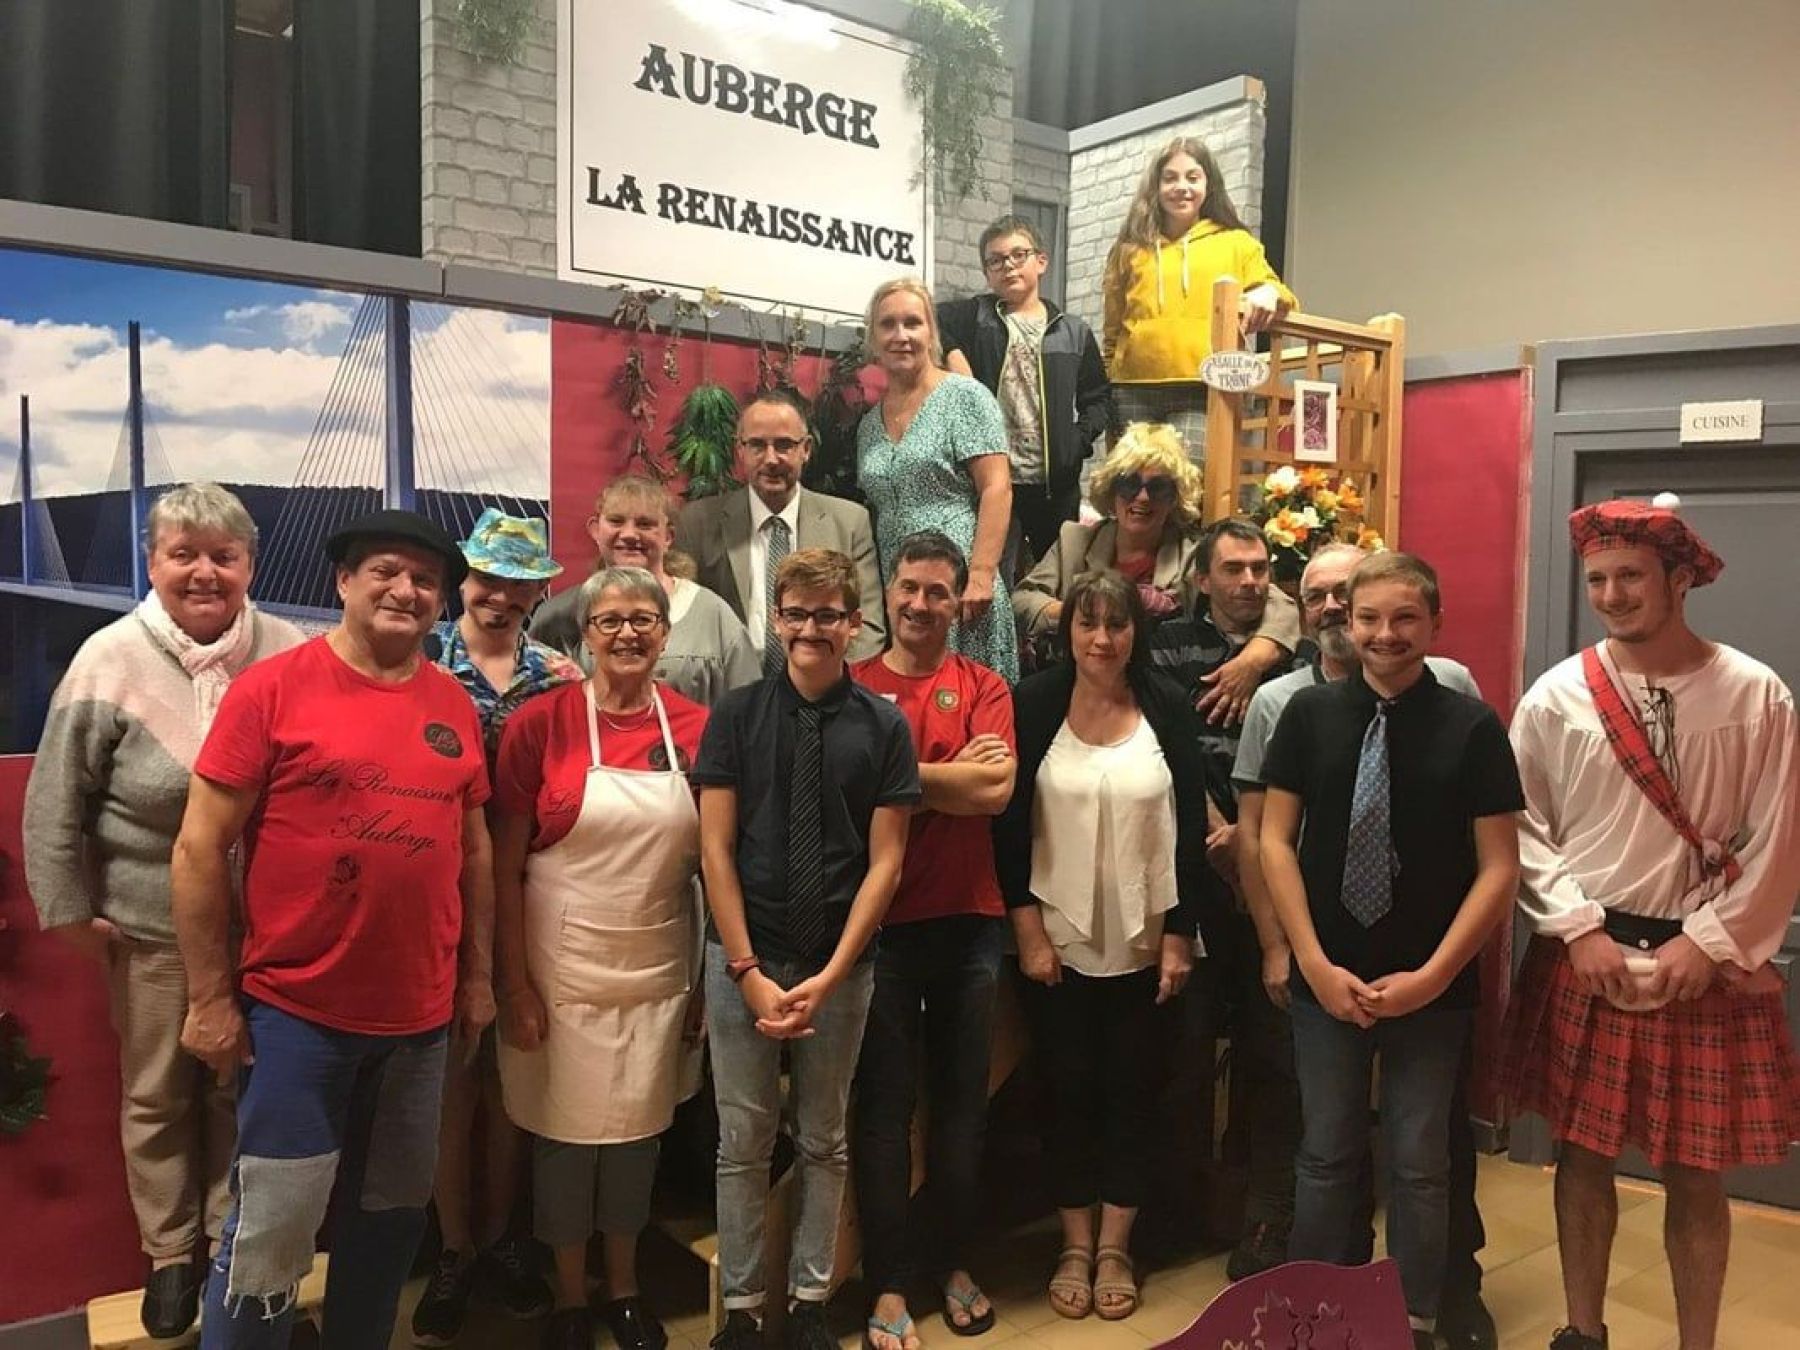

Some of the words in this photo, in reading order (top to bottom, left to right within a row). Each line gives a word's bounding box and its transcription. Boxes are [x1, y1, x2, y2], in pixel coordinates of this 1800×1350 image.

[634, 43, 880, 149] AUBERGE
[586, 166, 646, 215] LA
[657, 183, 916, 266] RENAISSANCE
[1693, 414, 1748, 429] CUISINE
[331, 810, 433, 857] Auberge
